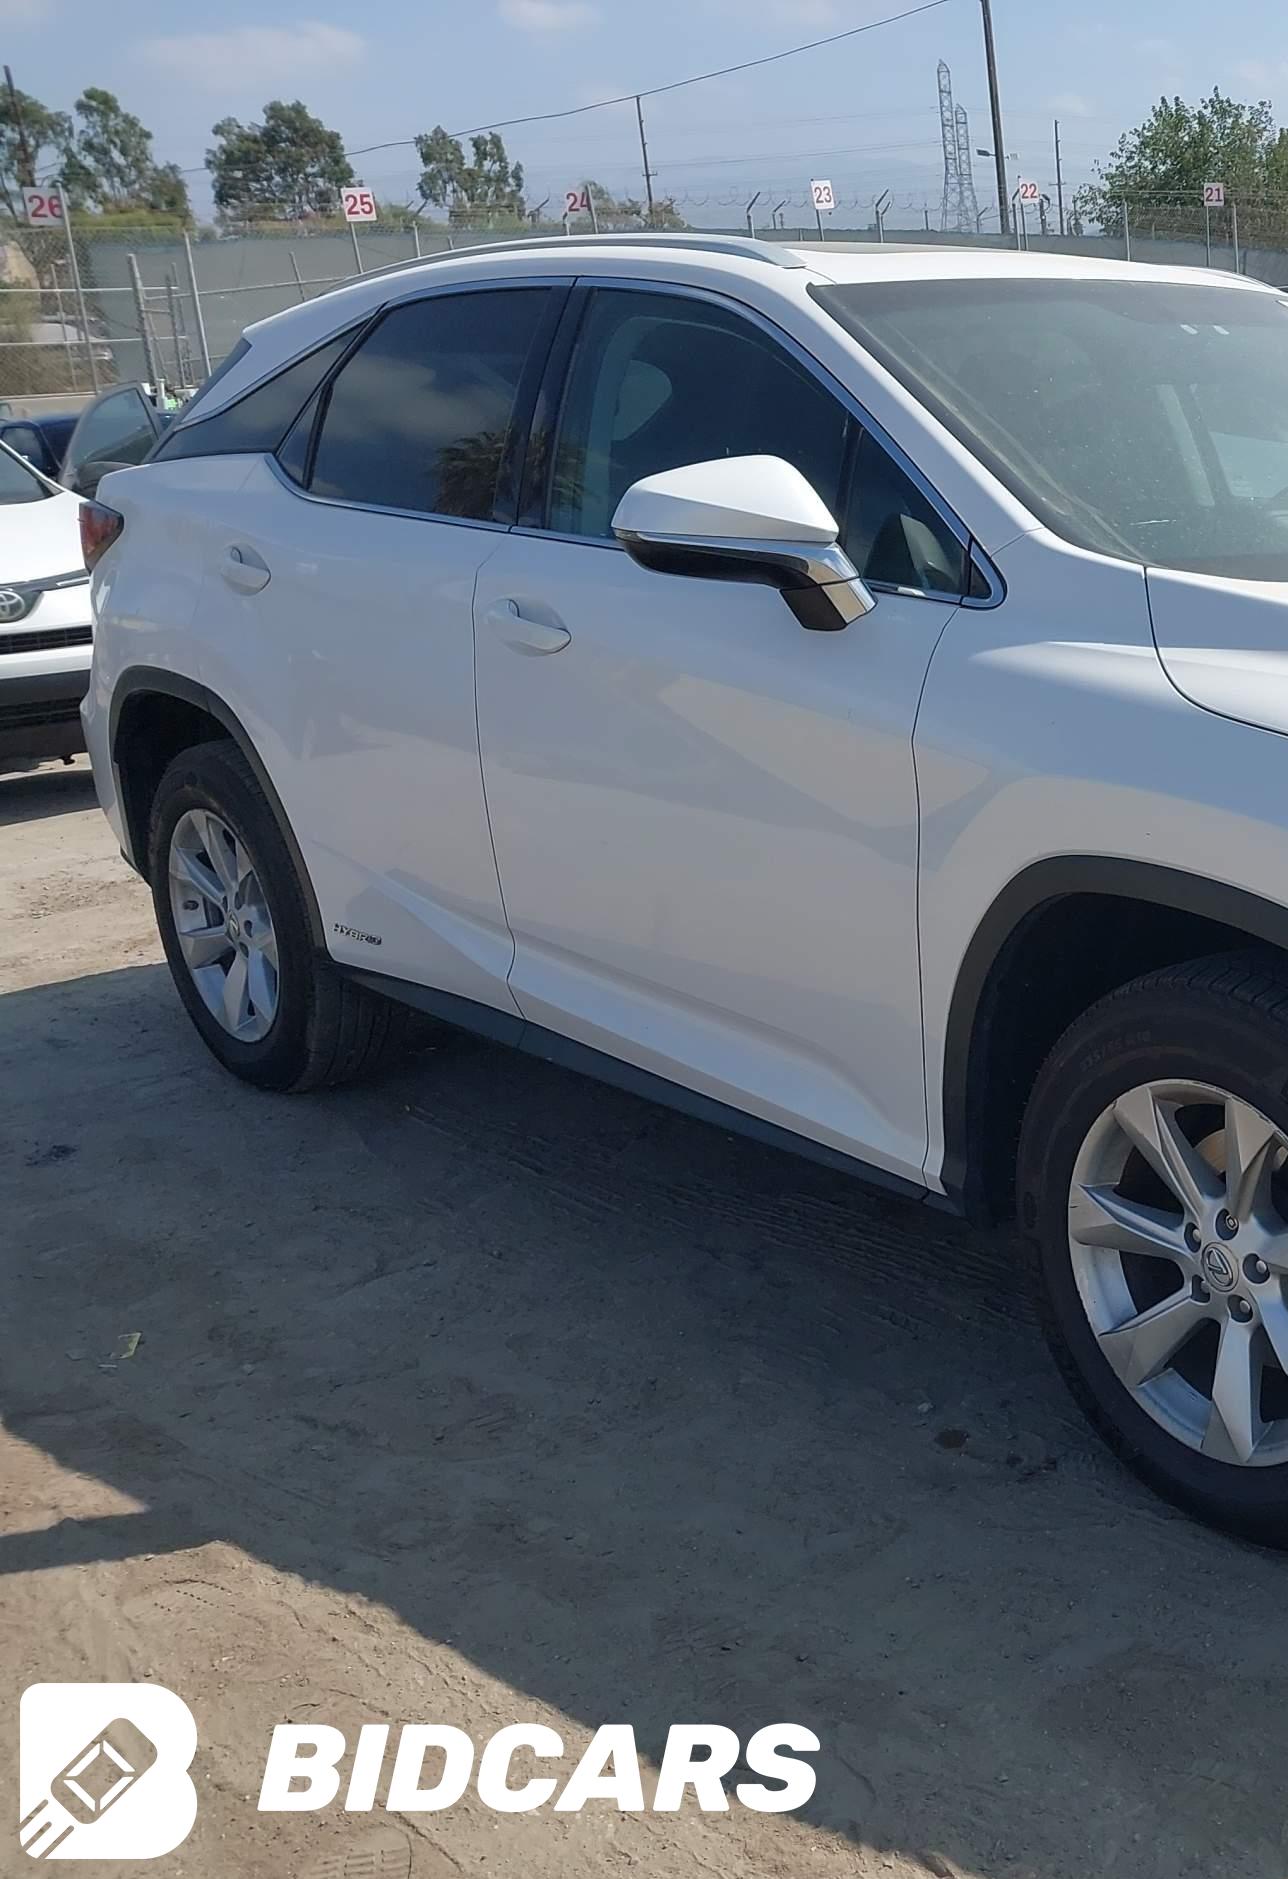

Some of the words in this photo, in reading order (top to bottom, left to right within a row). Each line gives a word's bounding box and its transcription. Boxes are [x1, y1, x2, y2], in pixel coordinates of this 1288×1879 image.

[814, 186, 832, 204] 23
[1020, 183, 1038, 199] 22
[1205, 187, 1222, 202] 21
[28, 194, 63, 218] 26
[344, 193, 374, 216] 25
[566, 191, 591, 212] 24
